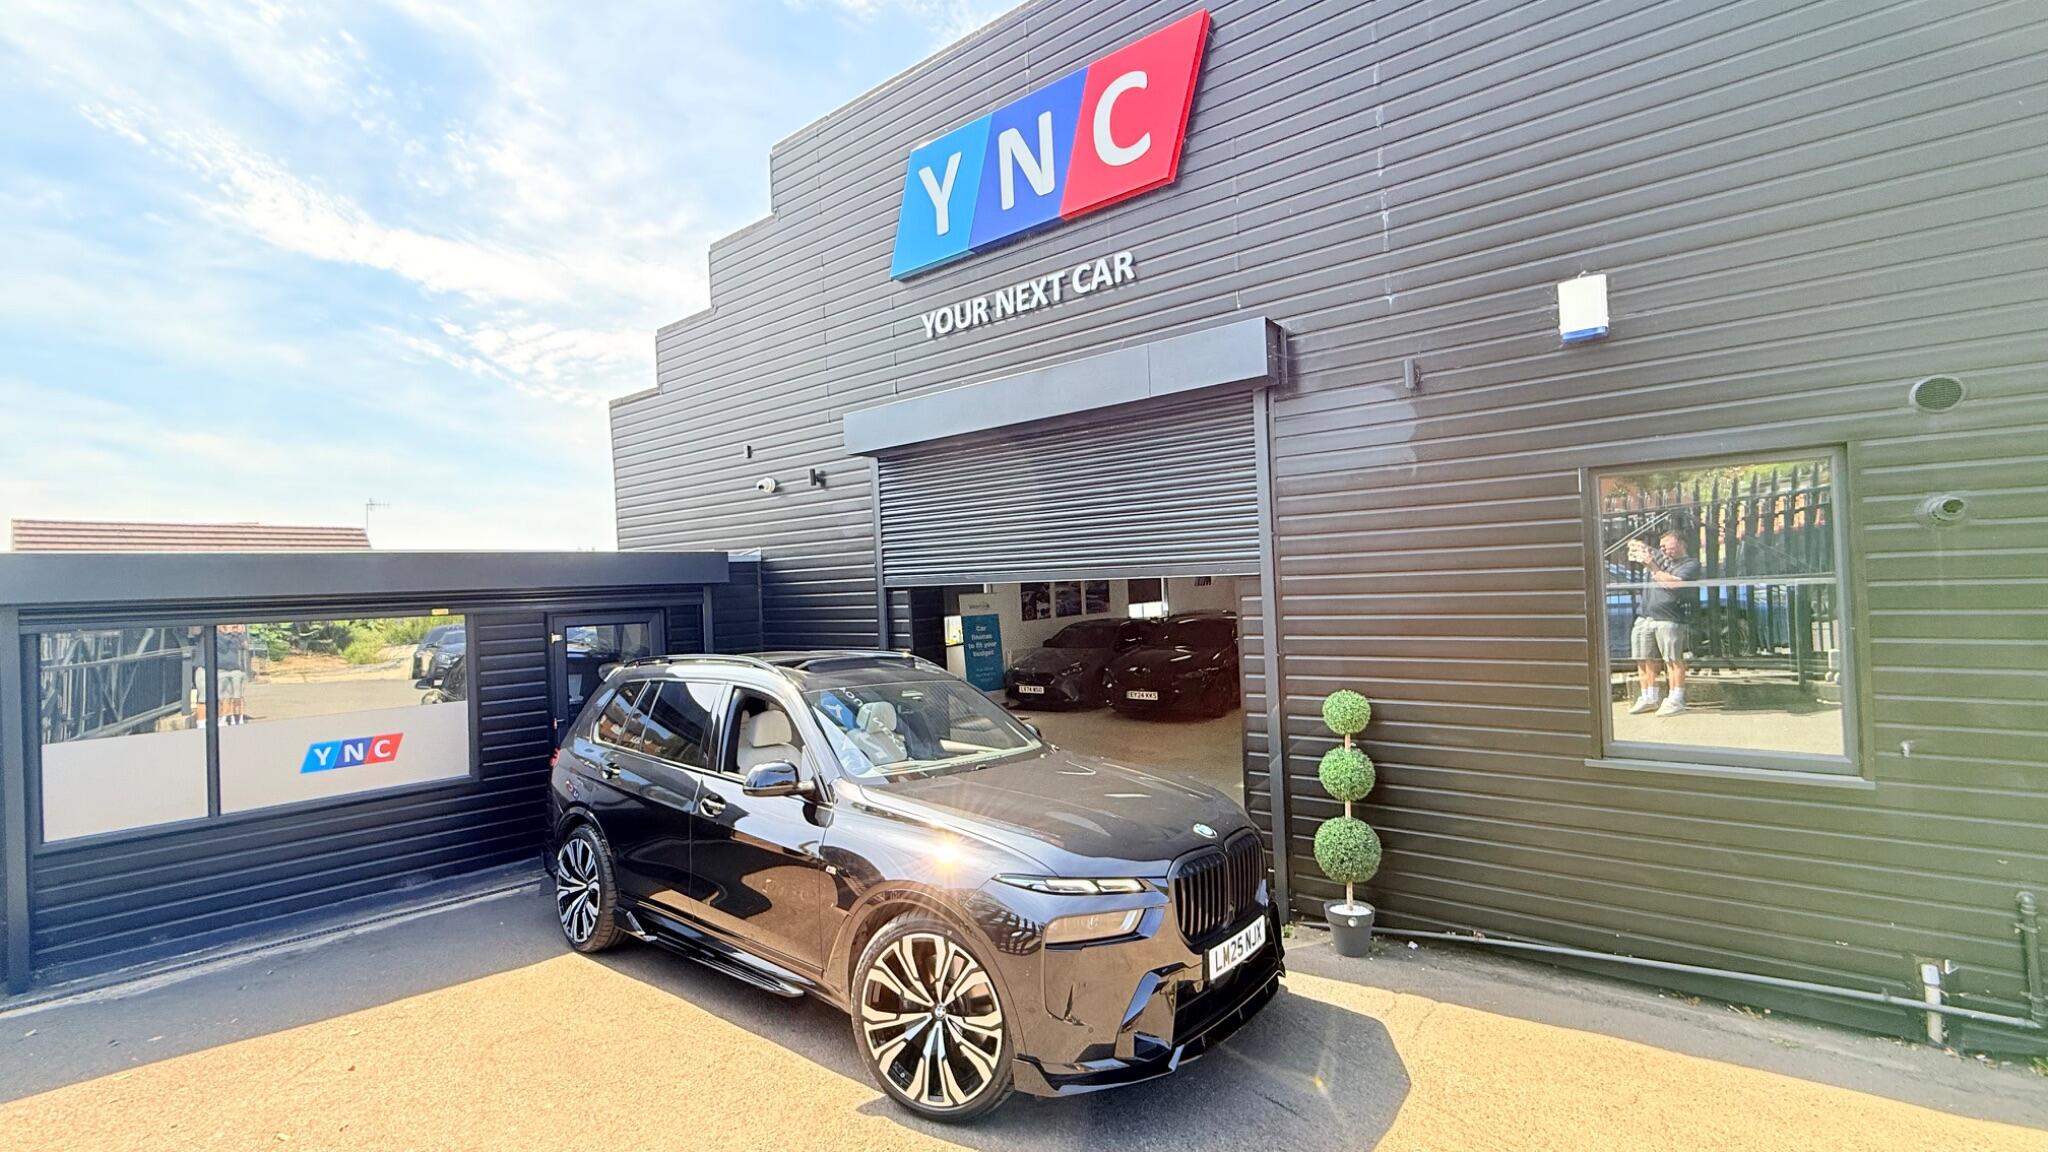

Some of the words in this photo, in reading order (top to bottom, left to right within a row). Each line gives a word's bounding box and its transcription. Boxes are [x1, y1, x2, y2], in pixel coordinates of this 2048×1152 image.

[918, 70, 1152, 236] YNC
[920, 296, 989, 338] YOUR
[995, 271, 1065, 318] NEXT
[1071, 250, 1136, 294] CAR
[983, 641, 997, 649] your
[313, 739, 391, 766] YNC
[1214, 935, 1244, 973] LM25
[1245, 920, 1262, 953] NJX
